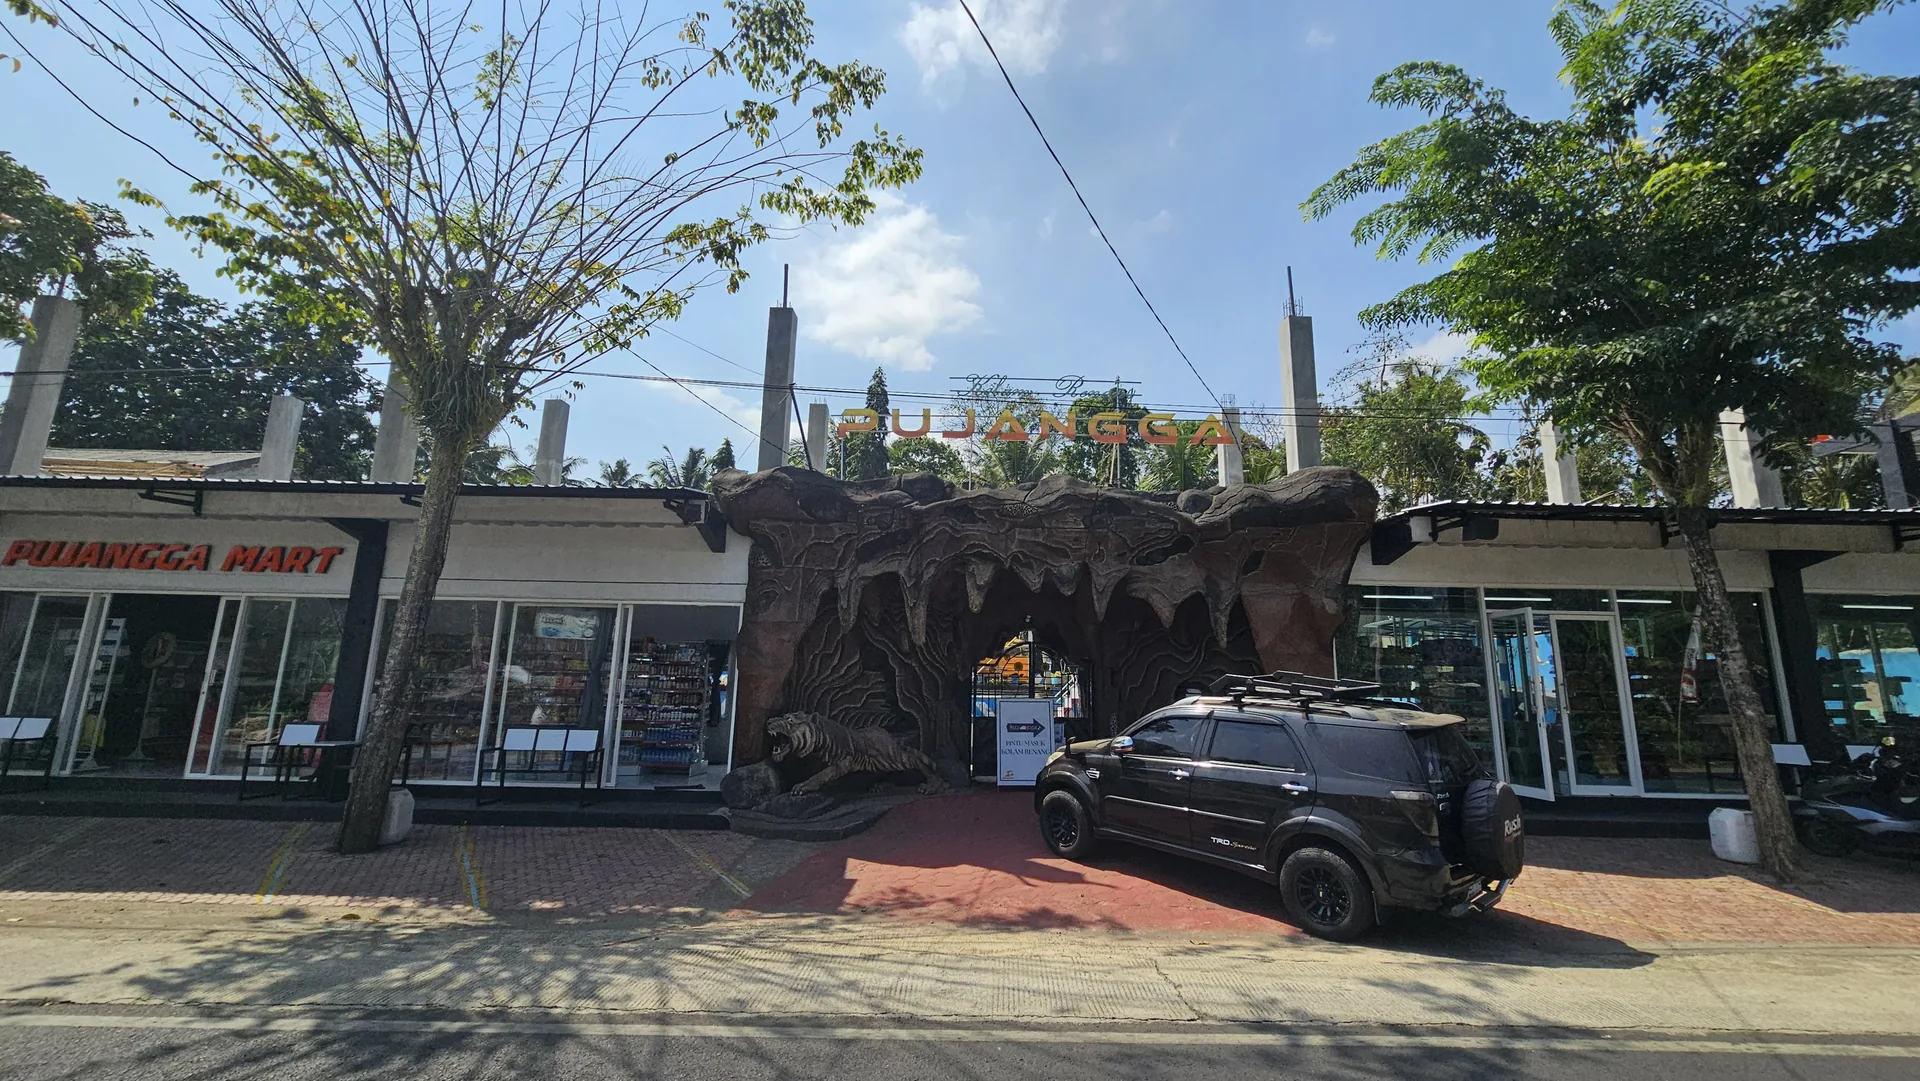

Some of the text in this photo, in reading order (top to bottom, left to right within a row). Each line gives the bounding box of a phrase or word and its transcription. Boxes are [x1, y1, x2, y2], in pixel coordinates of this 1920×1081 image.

[837, 407, 1236, 445] PUJANGGA
[1, 540, 345, 574] PUJANGGA MART
[1504, 814, 1521, 837] Rush
[1210, 836, 1230, 846] TRD
